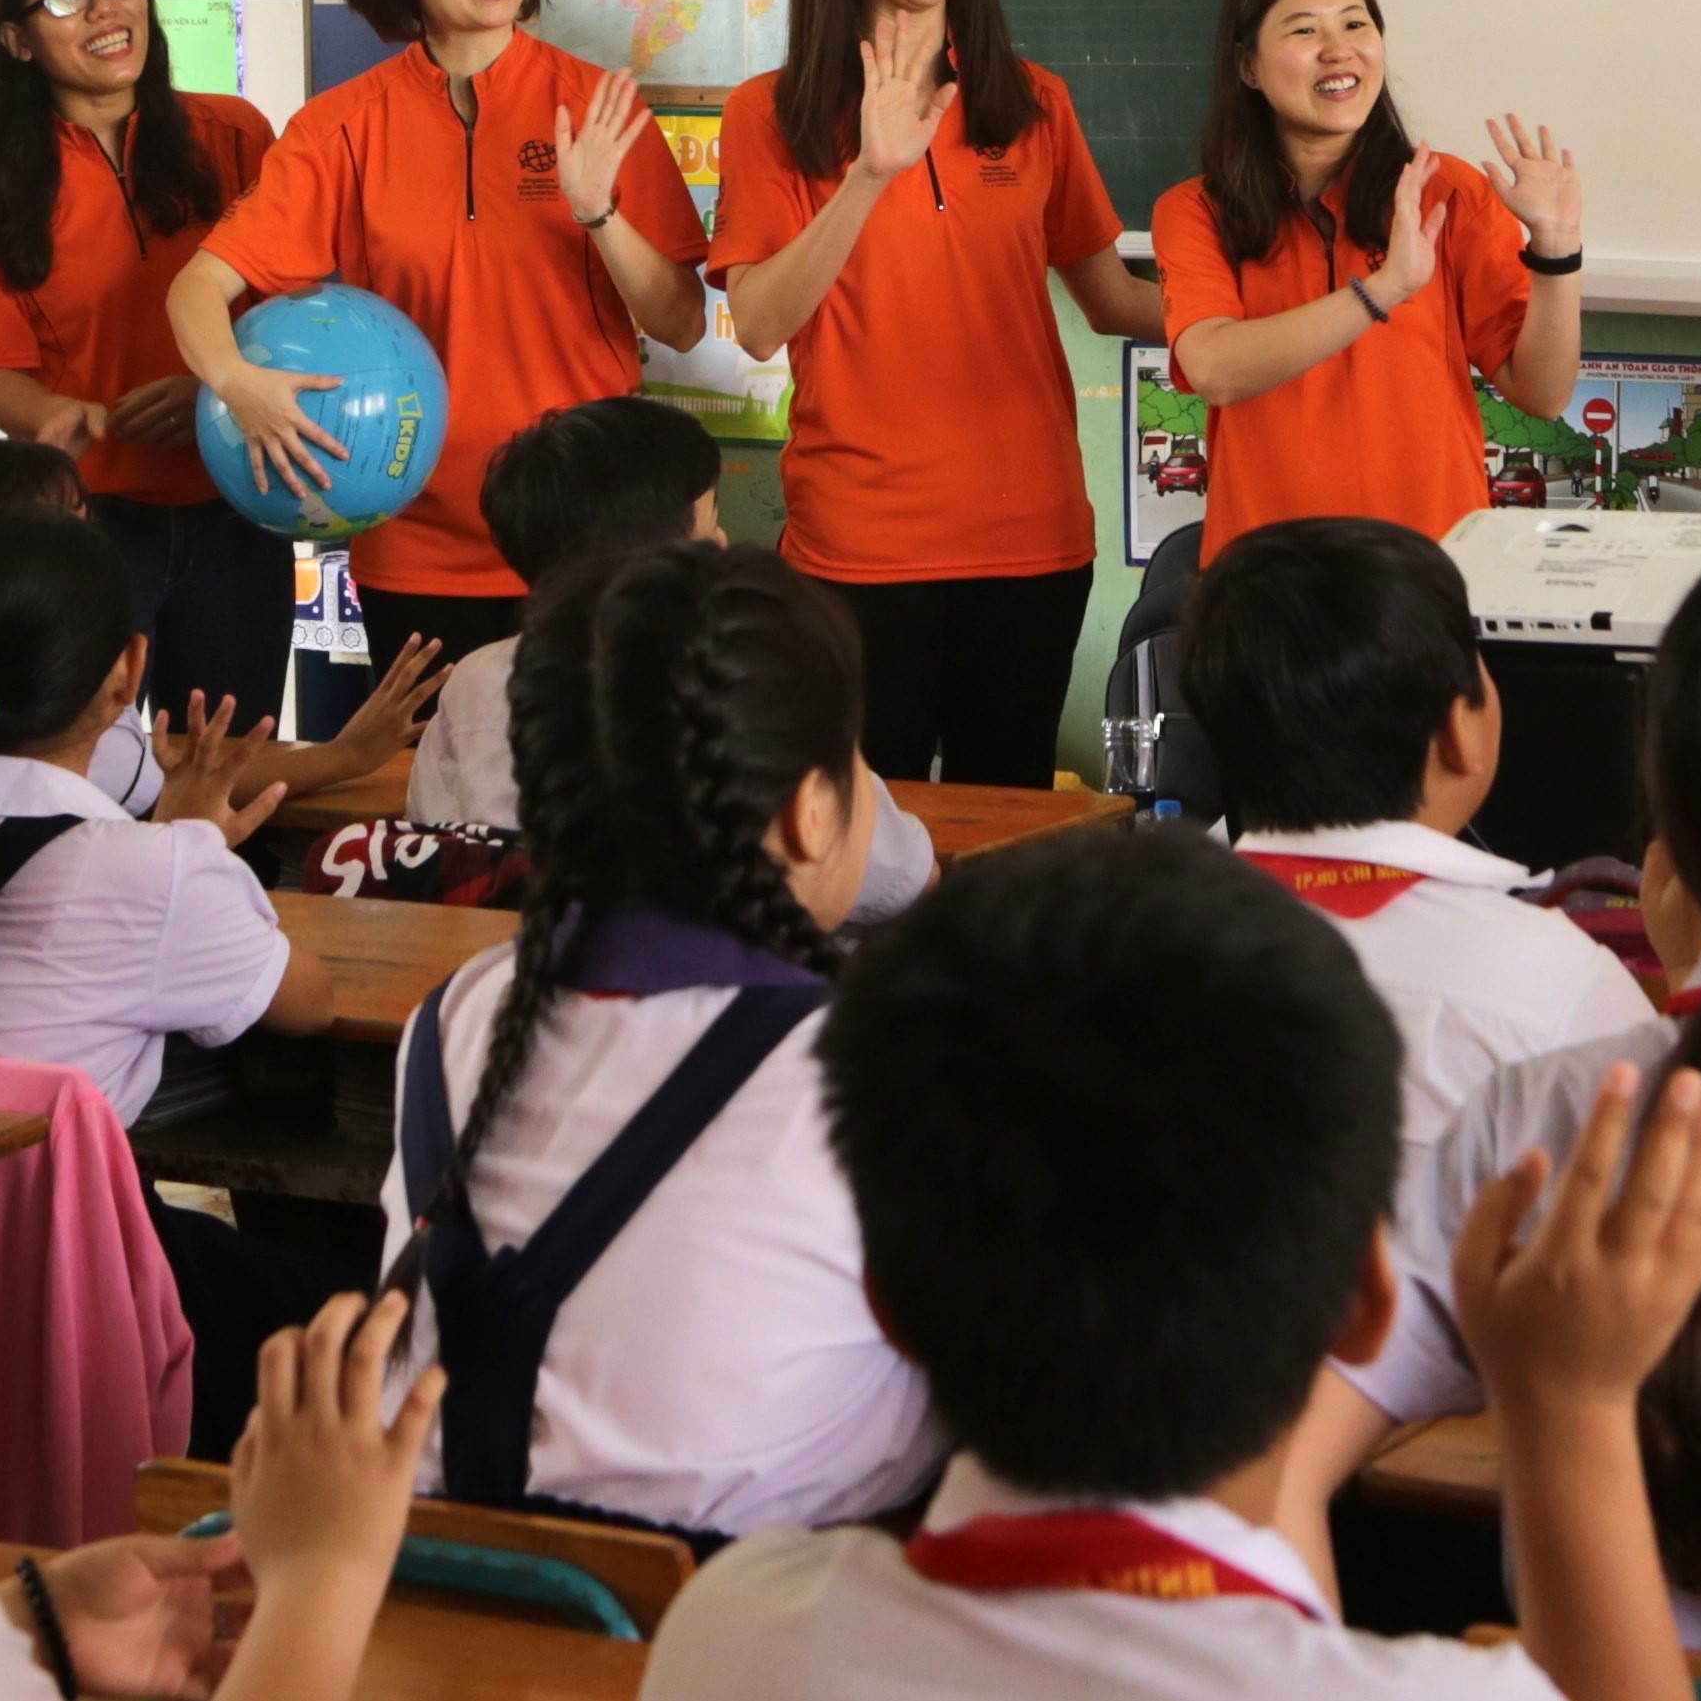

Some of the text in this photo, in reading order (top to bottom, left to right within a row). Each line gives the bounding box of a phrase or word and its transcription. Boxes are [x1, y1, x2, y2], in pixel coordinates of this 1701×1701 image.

[1605, 362, 1619, 371] AN
[1651, 363, 1675, 373] GIAO
[387, 418, 419, 479] KIDS
